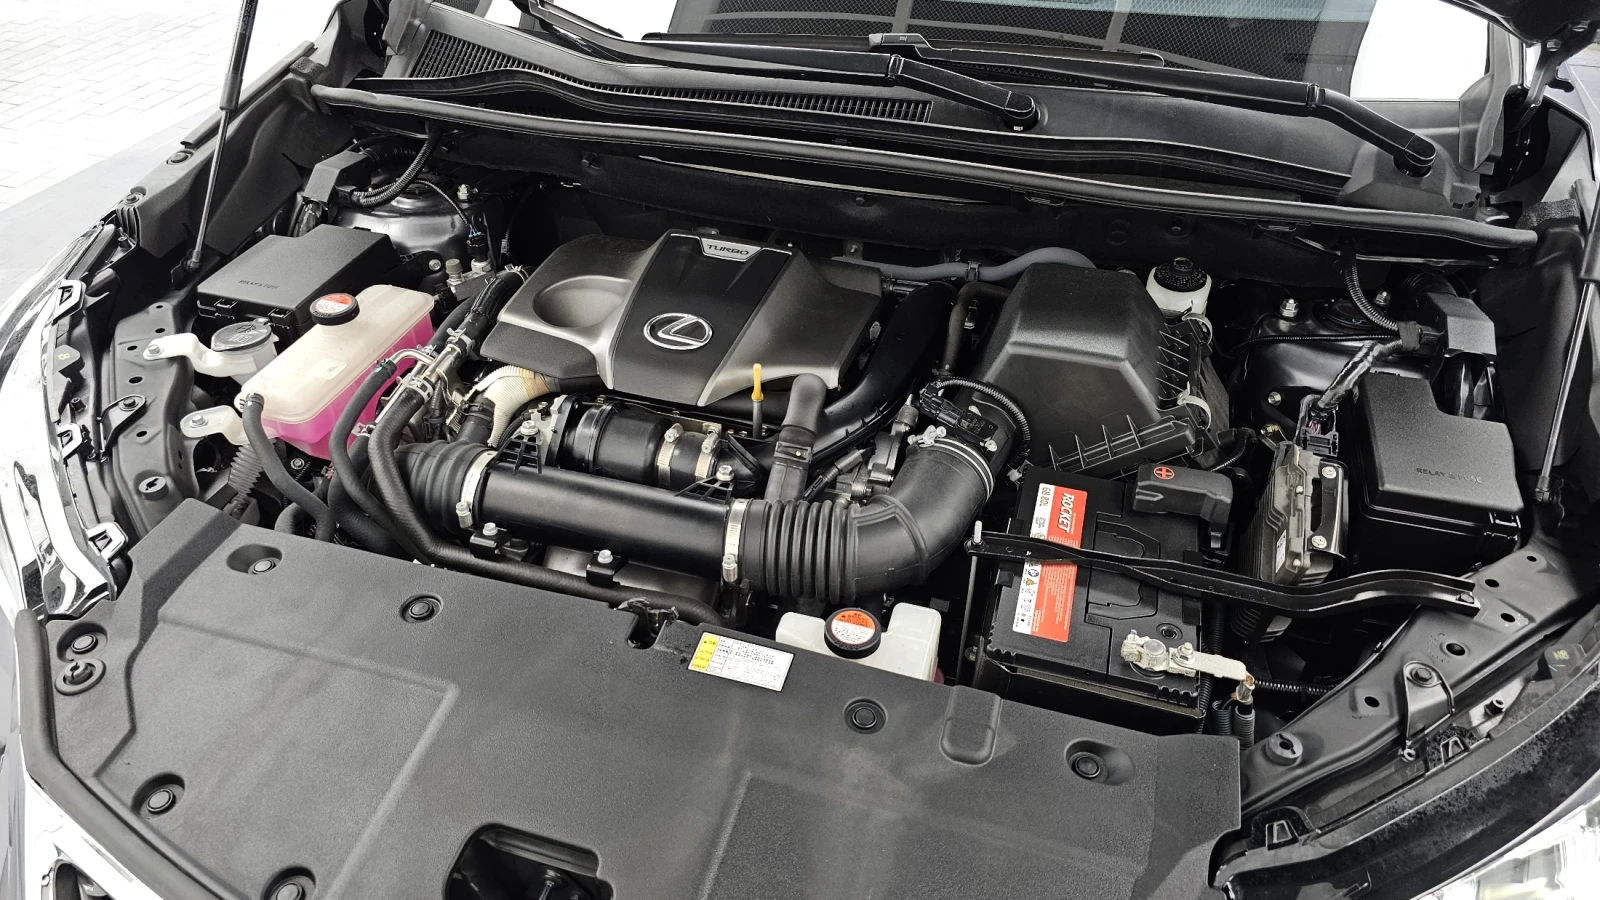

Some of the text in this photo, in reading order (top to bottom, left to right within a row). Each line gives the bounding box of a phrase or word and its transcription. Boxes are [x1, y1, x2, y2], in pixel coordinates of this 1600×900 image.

[707, 244, 749, 255] TURBO
[1416, 467, 1445, 477] RELAY
[1458, 474, 1483, 484] FUSE
[1057, 491, 1076, 534] ROCKET
